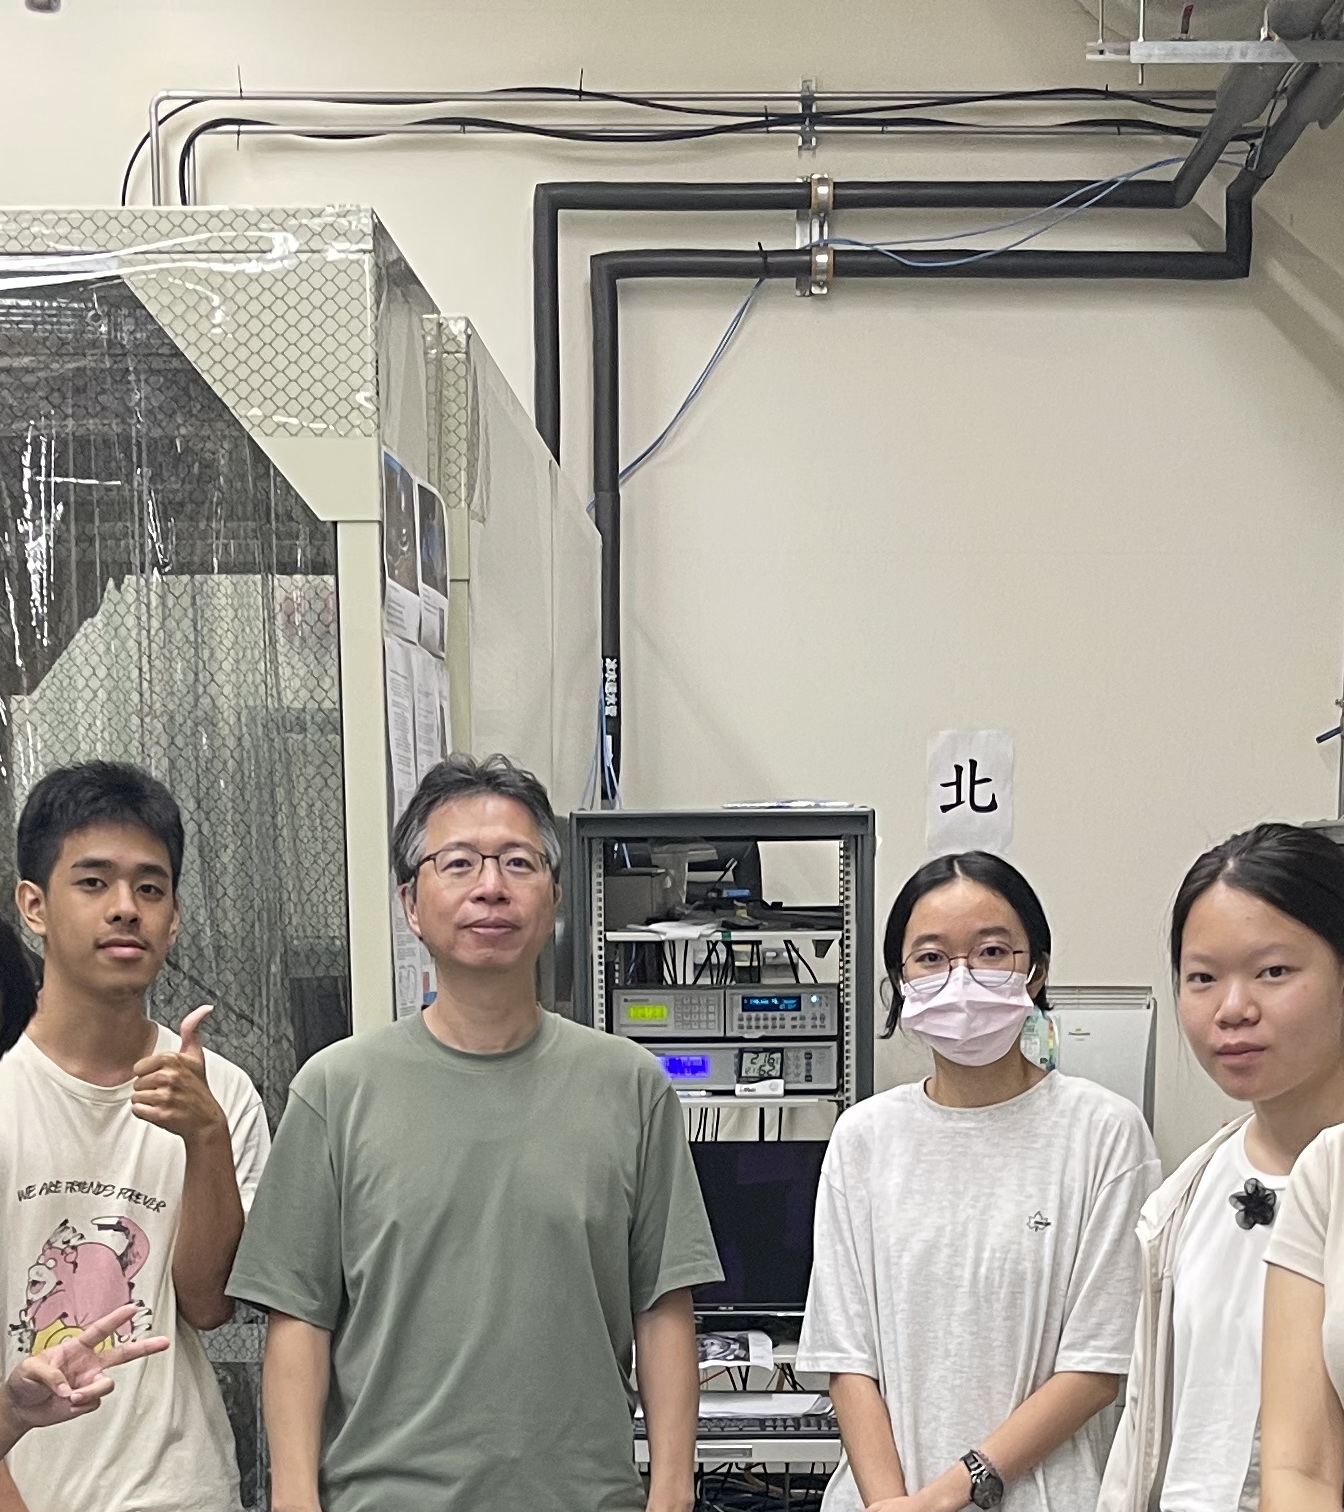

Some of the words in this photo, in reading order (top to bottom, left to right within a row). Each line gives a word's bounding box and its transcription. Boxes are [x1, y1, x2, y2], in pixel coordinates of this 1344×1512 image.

[939, 758, 999, 813] 北
[17, 1184, 36, 1201] WE
[39, 1180, 62, 1196] ARE
[64, 1180, 115, 1197] FRIENDS
[116, 1187, 166, 1213] FOREVER
